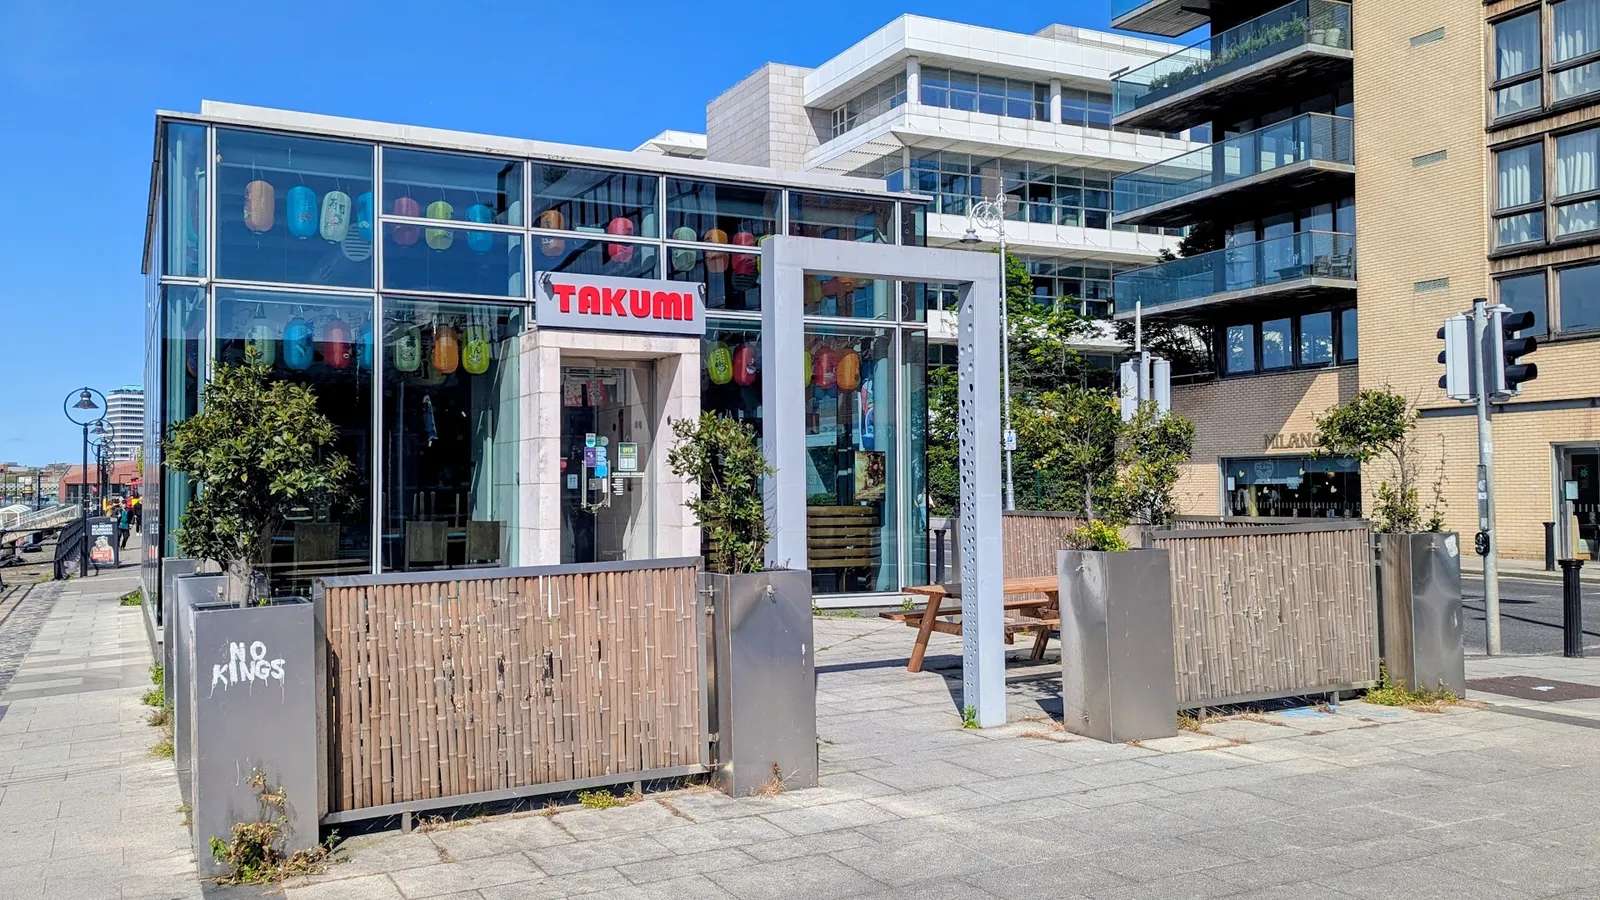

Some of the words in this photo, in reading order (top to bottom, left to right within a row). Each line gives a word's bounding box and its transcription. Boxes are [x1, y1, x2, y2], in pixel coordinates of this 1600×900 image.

[552, 284, 693, 321] TAKUMI
[230, 641, 267, 662] NO
[211, 658, 286, 692] KINGS
